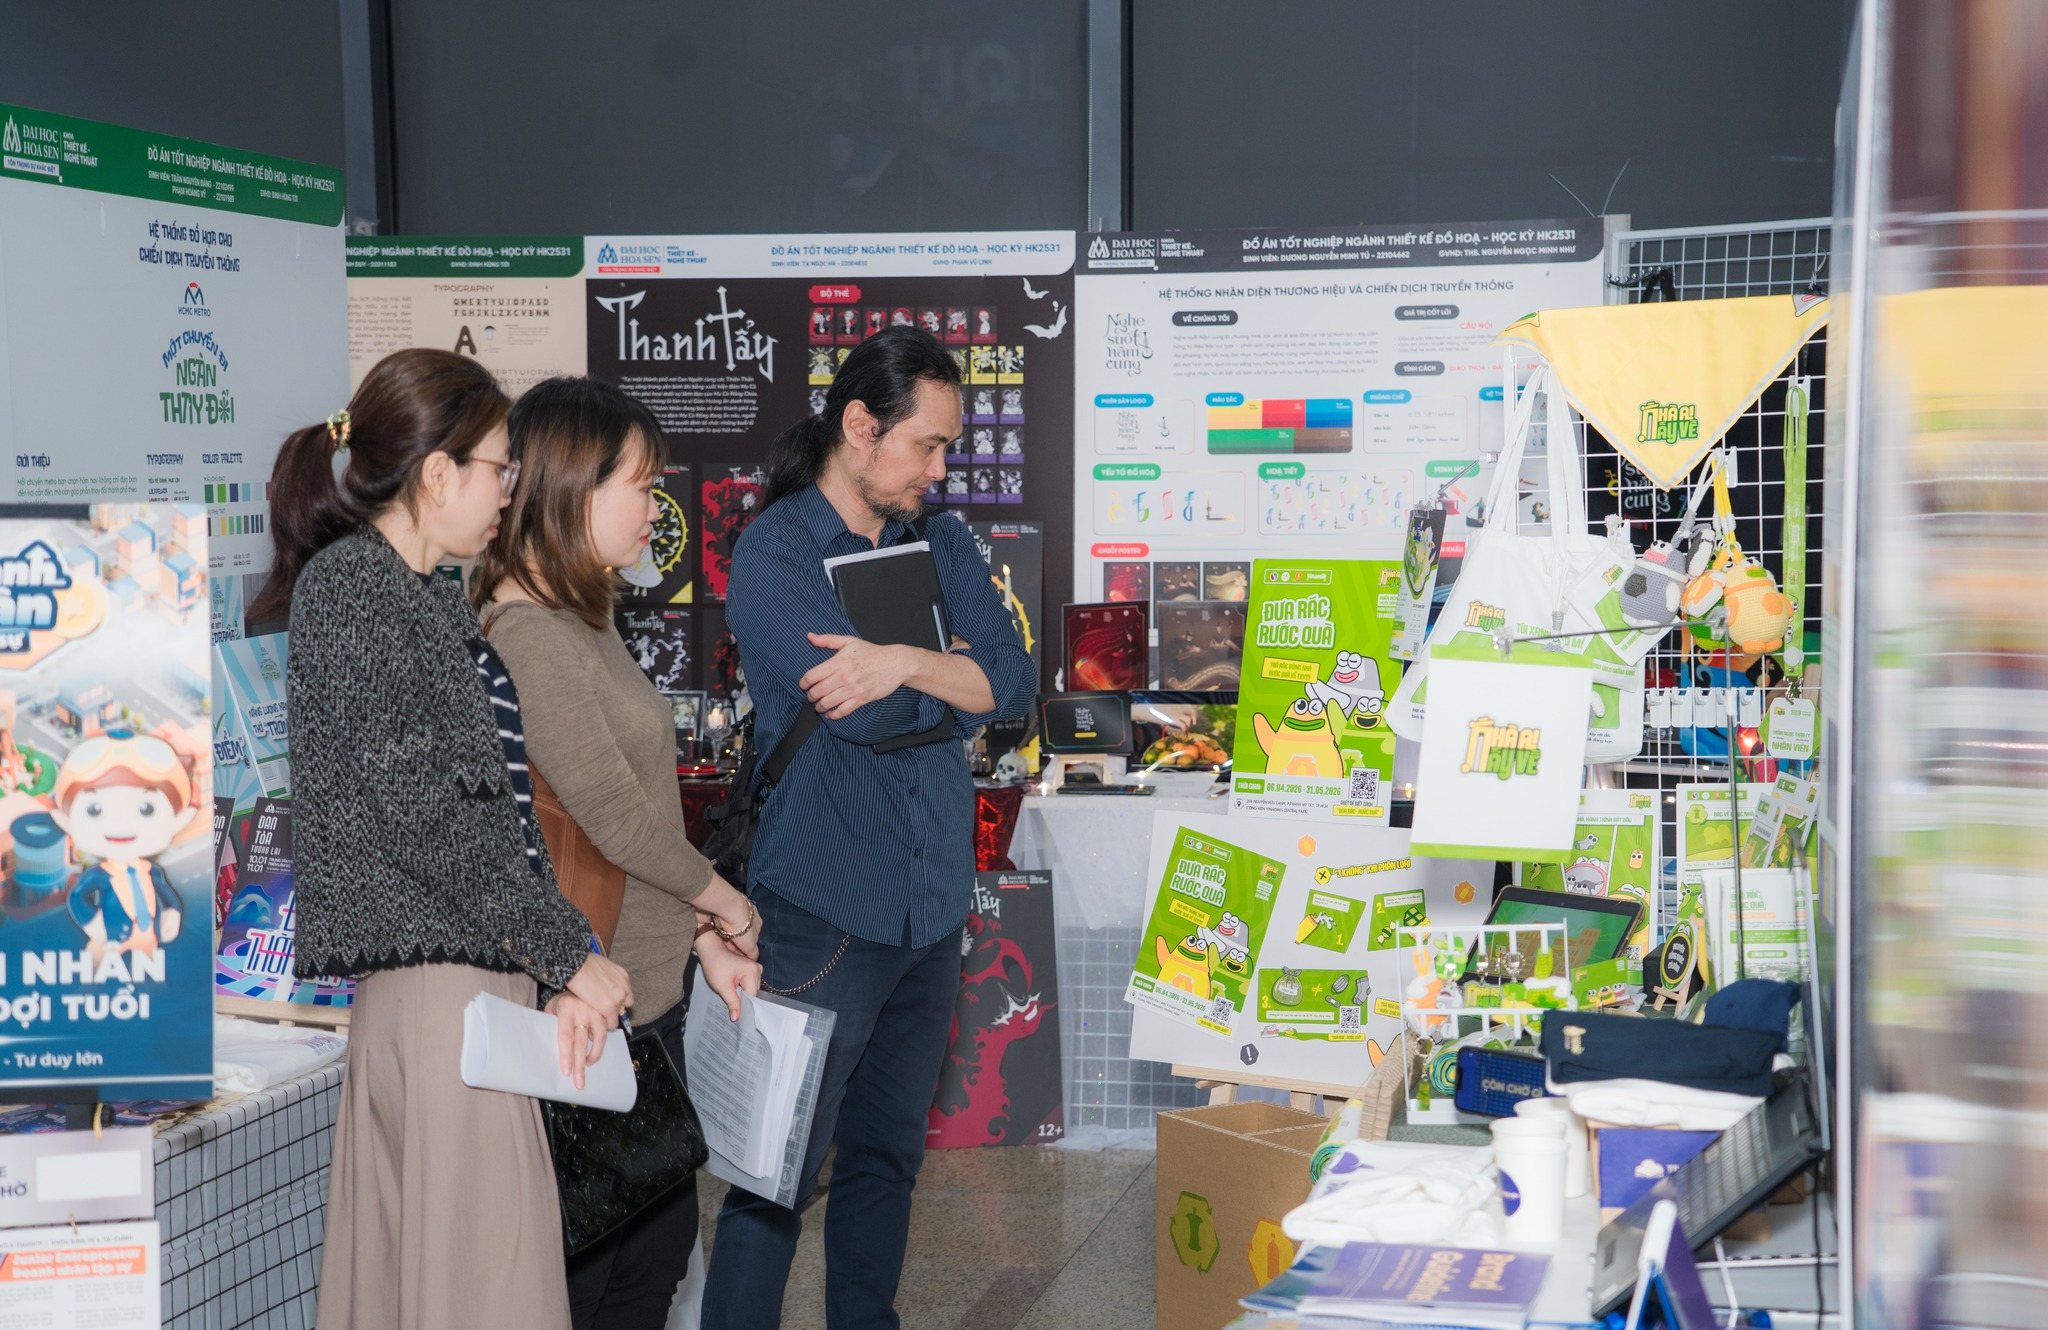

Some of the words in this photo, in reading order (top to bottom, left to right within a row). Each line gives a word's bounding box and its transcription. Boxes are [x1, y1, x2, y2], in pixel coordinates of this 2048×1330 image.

[24, 142, 42, 157] HOA
[44, 145, 59, 160] SEN
[219, 232, 232, 247] CHO
[1262, 237, 1277, 249] ÁN
[1280, 236, 1301, 248] TỐT
[1303, 235, 1344, 250] NGHIỆP
[1346, 235, 1385, 247] NGÀNH
[1387, 232, 1417, 245] THIẾT
[1419, 230, 1434, 244] KẾ
[1456, 233, 1480, 245] HOẠ
[1491, 232, 1517, 244] HỌC
[1520, 229, 1534, 241] KỲ
[1537, 230, 1576, 240] HK2531
[537, 247, 571, 256] HK2531
[787, 244, 800, 255] ÁN
[803, 244, 821, 255] TỐT
[824, 244, 858, 256] NGHIỆP
[861, 244, 895, 255] NGÀNH
[898, 243, 925, 254] THIẾT
[1025, 244, 1060, 252] HK2531
[1112, 249, 1135, 258] HOA
[1136, 249, 1155, 257] SEN
[1340, 252, 1359, 260] MINH
[1514, 247, 1537, 256] NGỌC
[1539, 246, 1558, 254] MINH
[1559, 245, 1576, 253] NHƯ
[621, 256, 641, 264] HOA
[643, 256, 660, 264] SEN
[433, 284, 494, 292] TYPOGRAPHY
[1159, 289, 1172, 300] HỆ
[1175, 285, 1211, 298] THỐNG
[1216, 287, 1244, 298] NHẬN
[1247, 286, 1271, 298] DIỆN
[1275, 286, 1319, 296] THƯƠNG
[1323, 284, 1345, 296] HIỆU
[1348, 283, 1363, 294] VÀ
[1366, 280, 1398, 294] CHIẾN
[1401, 283, 1427, 294] DỊCH
[1430, 279, 1472, 292] TRUYỀN
[1476, 280, 1514, 291] THÔNG
[194, 308, 211, 316] METRO
[595, 290, 716, 360] Thanh
[1104, 313, 1144, 337] Nghe
[176, 352, 216, 387] NGÀN
[1106, 360, 1142, 377] cung
[147, 454, 184, 465] TYPOGRAPHY
[202, 453, 219, 464] COLOR
[221, 453, 243, 464] PALETTE
[1302, 622, 1332, 645] QUÀ
[61, 984, 150, 1021] TUỔI
[40, 1052, 72, 1070] duy
[76, 1051, 103, 1066] lớn
[1038, 1124, 1063, 1137] 12+
